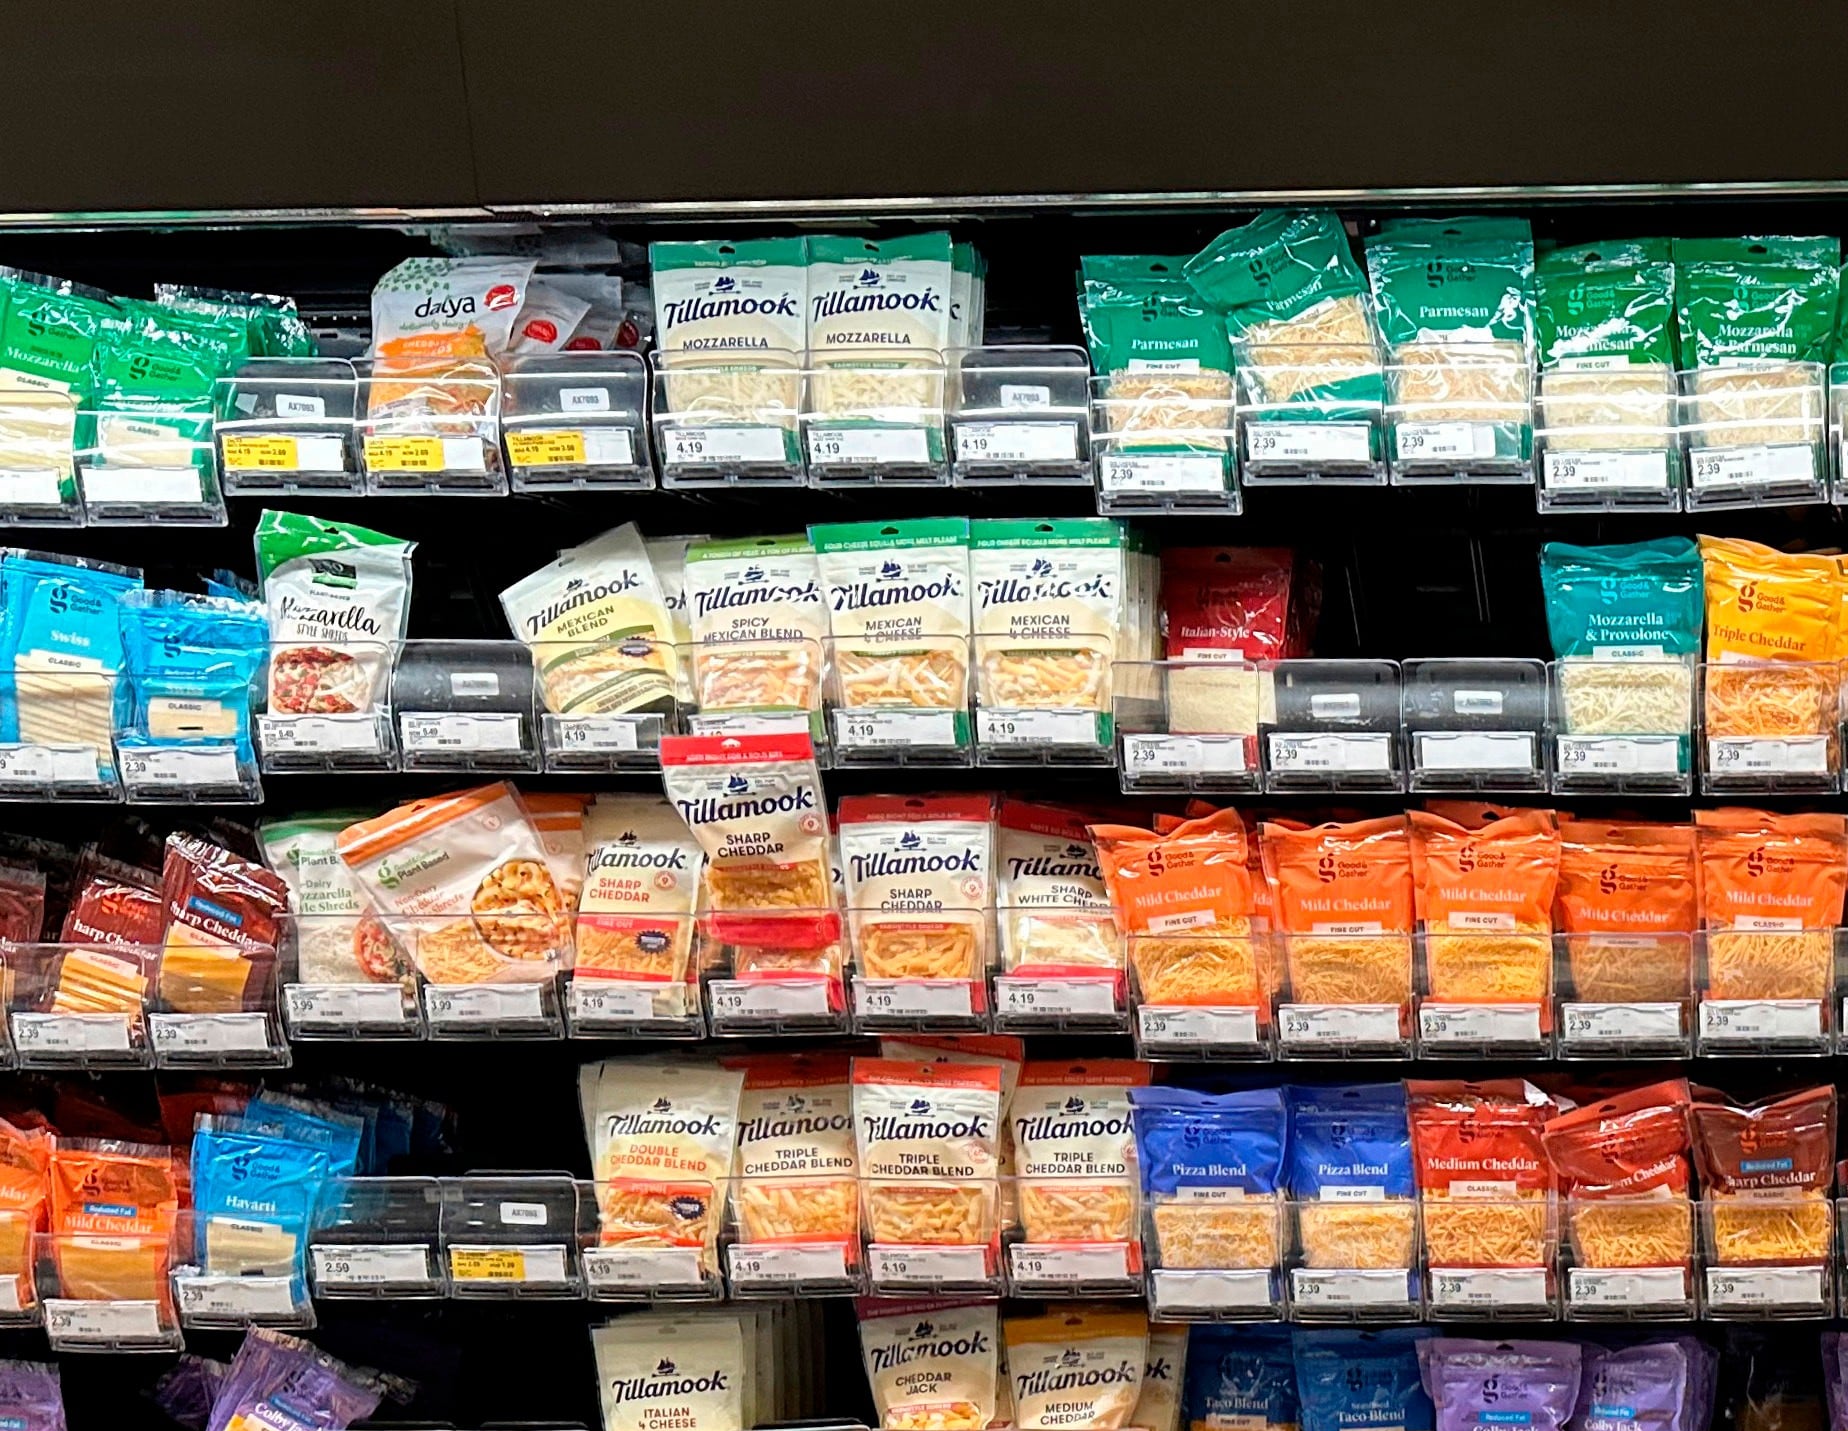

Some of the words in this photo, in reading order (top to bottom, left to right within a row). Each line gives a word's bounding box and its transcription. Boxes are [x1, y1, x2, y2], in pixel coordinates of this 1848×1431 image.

[1266, 280, 1323, 312] Parmesan
[664, 292, 797, 330] Tillamook
[812, 288, 940, 322] Tillamook
[1419, 304, 1489, 318] Parmesan
[1718, 323, 1793, 338] Mozzarella
[682, 337, 769, 350] MOZZARELLA
[826, 332, 911, 345] MOZZARELLA
[1130, 337, 1199, 350] Parmesan
[6, 347, 80, 374] Mozzarella
[676, 441, 703, 453] 4.19
[814, 442, 840, 454] 4.19
[1110, 469, 1133, 480] 2.39
[1553, 465, 1575, 477] 2.39
[831, 573, 960, 611] Tillamook
[526, 570, 639, 637] Tillamook
[695, 582, 819, 618] Tillamook
[557, 605, 615, 634] MEXICAN
[732, 617, 770, 629] SPICY
[866, 616, 922, 631] MEXICAN
[1010, 614, 1070, 626] MEXICAN
[1588, 613, 1664, 626] Mozzarella
[567, 616, 609, 638] BLEND
[1181, 625, 1250, 639] Italian-Style
[50, 630, 91, 646] Swiss
[704, 629, 756, 643] MEXICAN
[761, 628, 803, 638] BLEND
[1586, 629, 1599, 641] &
[1600, 627, 1670, 642] Provolone
[1713, 624, 1746, 644] Triple
[1748, 631, 1806, 651] Cheddar
[988, 723, 1015, 734] 4.19
[564, 730, 586, 741] 4.19
[1133, 750, 1155, 761] 2.39
[1717, 749, 1740, 761] 2.39
[677, 786, 814, 827] Tillamook
[726, 832, 771, 845] SHARP
[717, 843, 784, 859] CHEDDAR
[301, 856, 328, 866] Plant
[850, 849, 980, 882] Tillamook
[599, 878, 642, 889] SHARP
[589, 888, 650, 902] CHEDDAR
[889, 888, 933, 899] SHARP
[1050, 884, 1093, 899] SHARP
[1135, 891, 1163, 908] Mild
[1164, 886, 1222, 901] Cheddar
[1438, 888, 1468, 901] Mild
[1470, 889, 1526, 902] Cheddar
[1018, 894, 1061, 906] WHITE
[1301, 898, 1330, 911] Mild
[1333, 898, 1392, 911] Cheddar
[1726, 891, 1755, 905] Mild
[1758, 894, 1814, 906] Cheddar
[881, 899, 943, 913] CHEDDAR
[1580, 908, 1608, 922] Mild
[1610, 910, 1668, 923] Cheddar
[717, 996, 741, 1008] 4.19
[1009, 993, 1034, 1004] 4.19
[292, 1000, 313, 1012] 3.99
[431, 1000, 452, 1011] 3.99
[1144, 1021, 1166, 1033] 2.39
[1569, 1020, 1591, 1031] 2.39
[608, 1114, 721, 1138] Tillamook
[864, 1115, 988, 1143] Tillamook
[629, 1145, 679, 1158] DOUBLE
[775, 1148, 819, 1160] TRIPLE
[1053, 1152, 1094, 1163] TRIPLE
[610, 1155, 663, 1169] CHEDDAR
[664, 1158, 707, 1172] BLEND
[745, 1158, 809, 1174] CHEDDAR
[810, 1157, 853, 1169] BLEND
[899, 1153, 940, 1165] TRIPLE
[1427, 1157, 1479, 1170] Medium
[1480, 1158, 1539, 1171] Cheddar
[871, 1164, 930, 1176] CHEDDAR
[932, 1165, 974, 1177] BLEND
[1026, 1162, 1084, 1174] CHEDDAR
[1086, 1163, 1126, 1175] BLEND
[1172, 1164, 1205, 1176] Pizza
[1207, 1164, 1247, 1176] Blend
[1318, 1163, 1351, 1176] Pizza
[1353, 1163, 1389, 1176] Blend
[1632, 1158, 1678, 1184] Cheddar
[226, 1195, 276, 1213] Havarti
[65, 1215, 93, 1233] Mild
[95, 1218, 153, 1235] Cheddar
[325, 1262, 350, 1274] 2.59
[589, 1263, 610, 1275] 4.19
[881, 1262, 906, 1273] 4.19
[1440, 1282, 1461, 1293] 2.39
[870, 1331, 989, 1374] Tillamook
[895, 1372, 952, 1386] CHEDDAR
[1017, 1361, 1135, 1400] Tillamook
[612, 1370, 728, 1404] Tillamook
[906, 1383, 938, 1395] JACK
[1045, 1401, 1094, 1413] MEDIUM
[1206, 1397, 1232, 1409] Taco
[1234, 1398, 1269, 1410] Blend
[254, 1402, 287, 1431] Colby
[644, 1408, 690, 1418] ITALIAN
[1040, 1410, 1095, 1425] CHEDDAR
[1337, 1410, 1367, 1423] Taco
[1368, 1408, 1406, 1422] Blend
[649, 1418, 696, 1429] CHEESE
